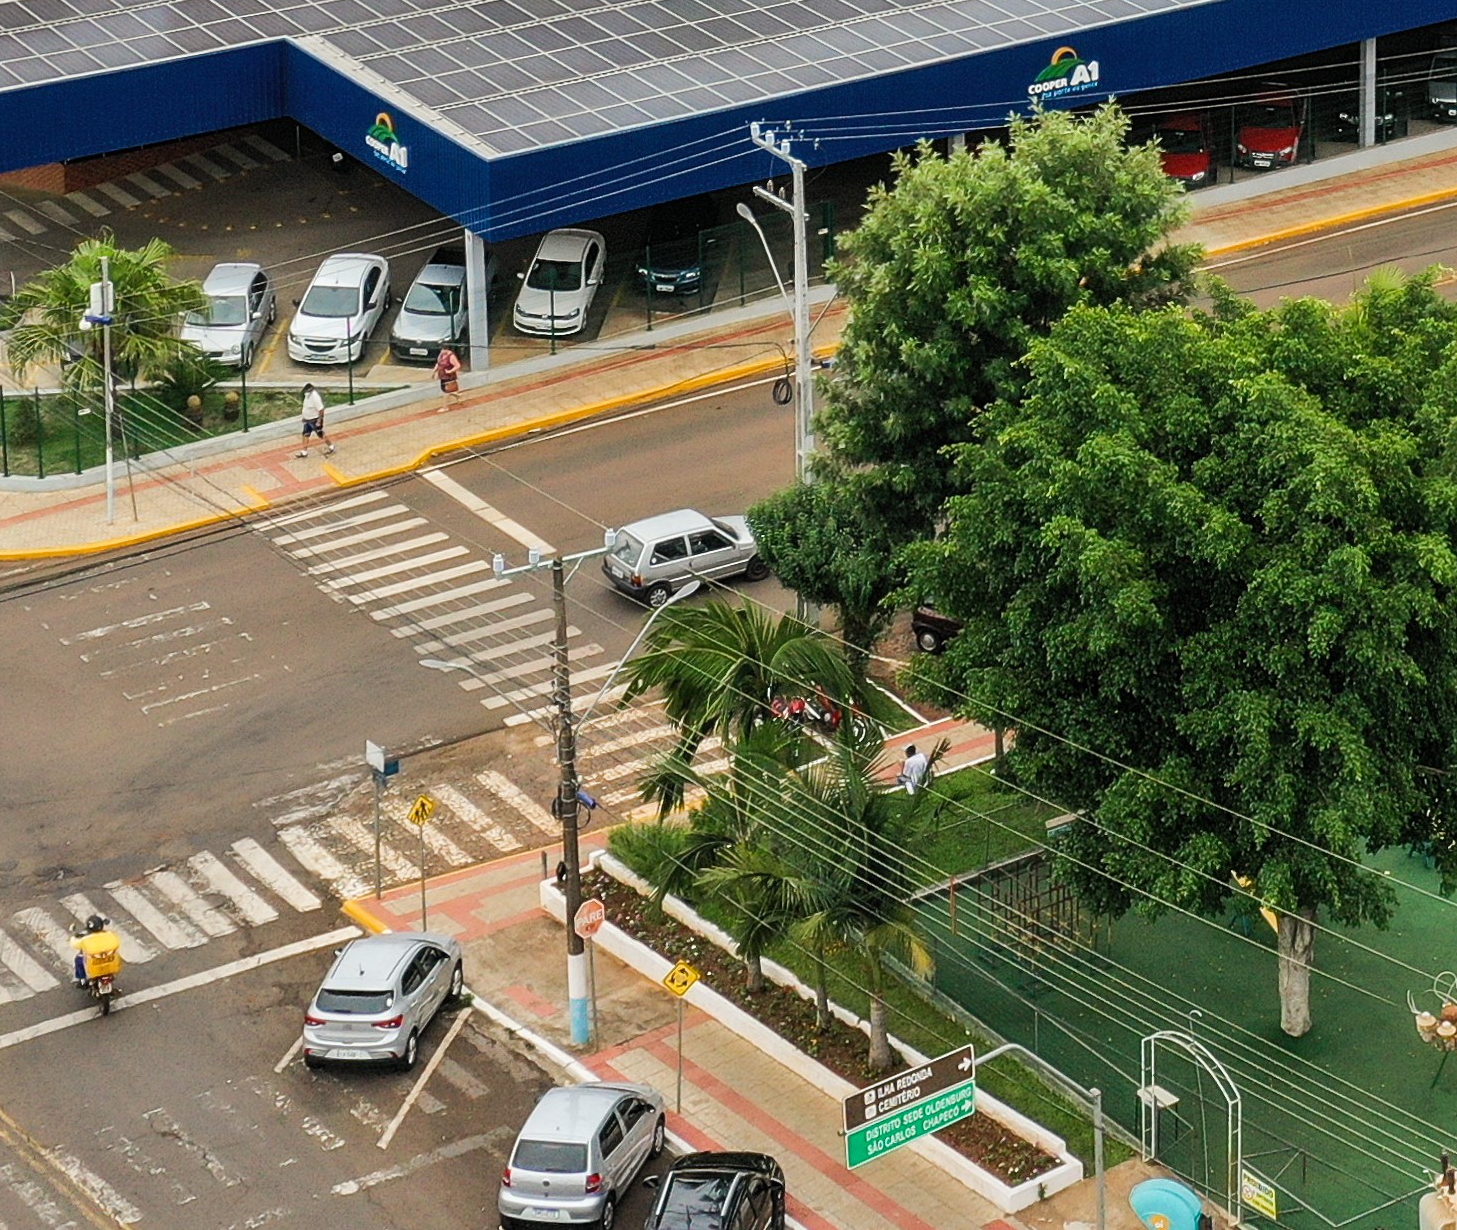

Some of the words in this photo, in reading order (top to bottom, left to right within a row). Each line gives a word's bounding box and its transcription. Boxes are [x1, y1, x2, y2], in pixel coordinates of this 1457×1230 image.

[1027, 77, 1068, 95] COOPER
[1069, 60, 1100, 86] A1
[576, 908, 603, 929] PARE
[877, 1082, 896, 1099] ILHA
[897, 1067, 934, 1091] REDONDA
[866, 1117, 902, 1142] DISTRITO
[903, 1106, 924, 1125] SEDE
[925, 1086, 972, 1116] OLDENBURG
[878, 1087, 921, 1113] CEMITÉRIO
[867, 1139, 884, 1156] SÃO
[884, 1124, 917, 1148] CARLOS
[923, 1105, 960, 1131] CHAPECÓ
[1154, 1219, 1164, 1229] oi
